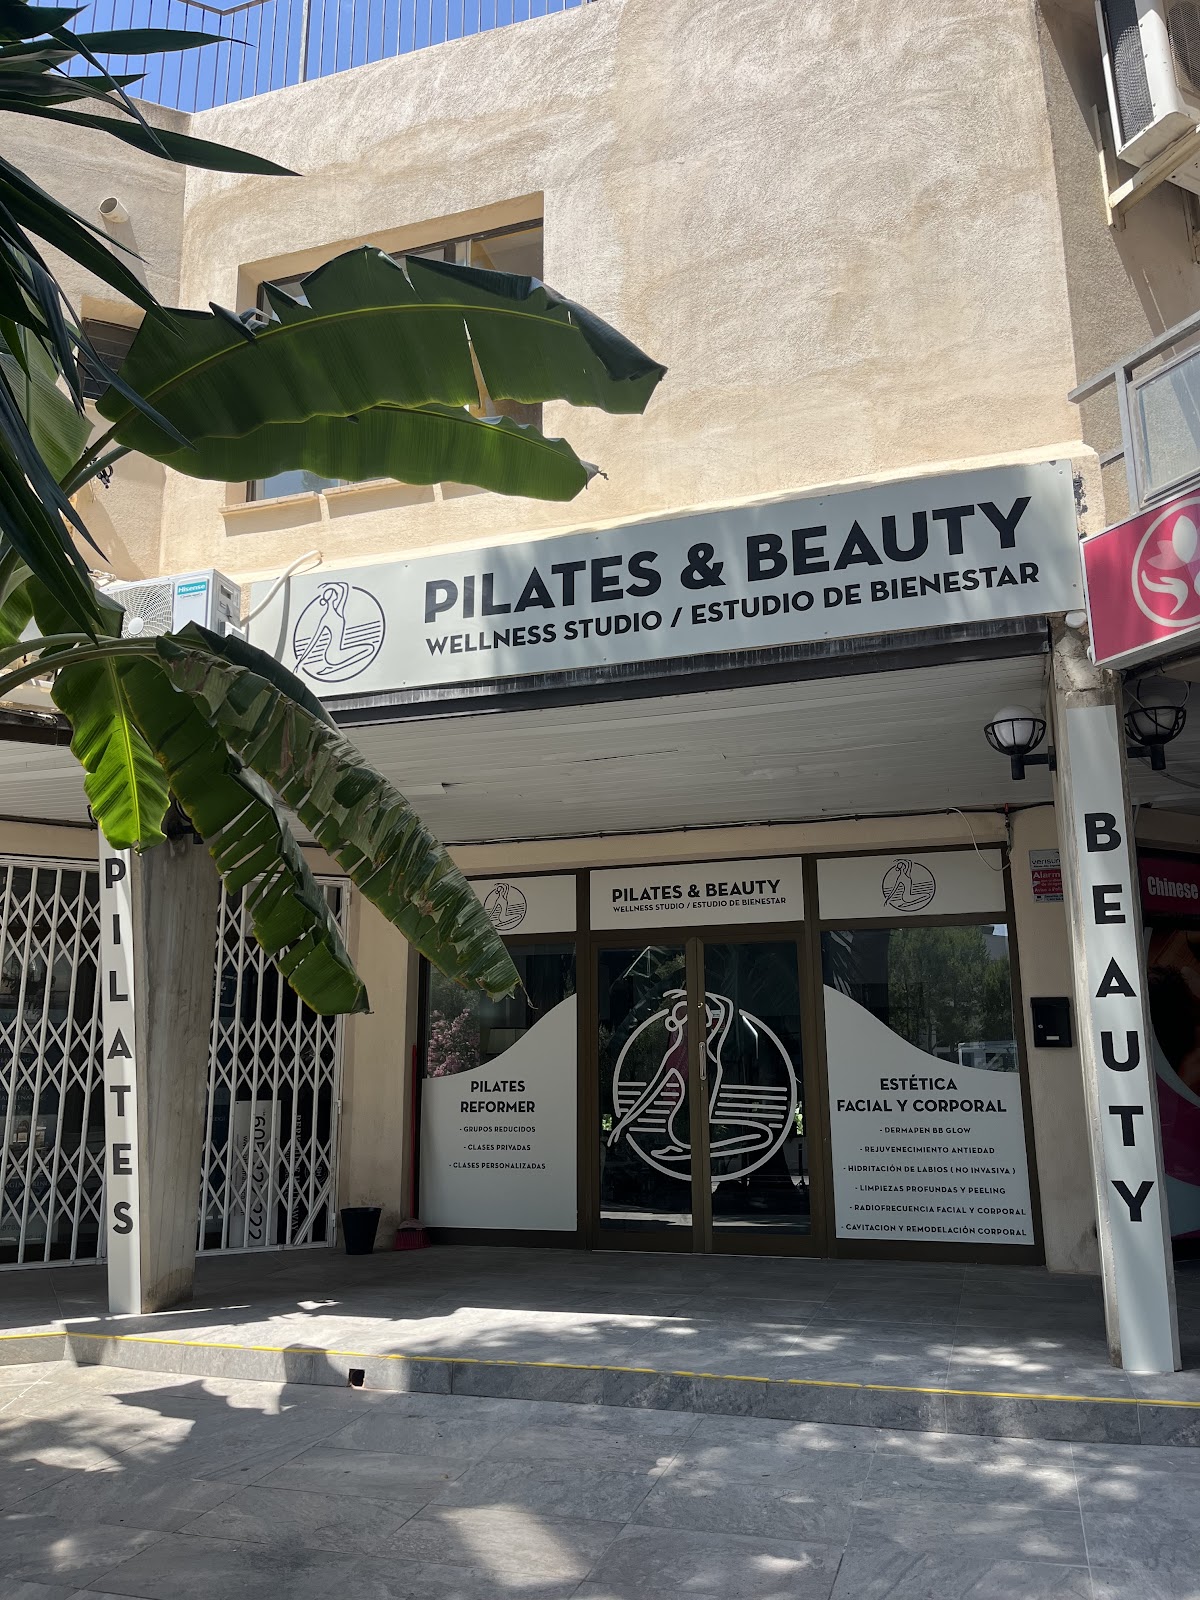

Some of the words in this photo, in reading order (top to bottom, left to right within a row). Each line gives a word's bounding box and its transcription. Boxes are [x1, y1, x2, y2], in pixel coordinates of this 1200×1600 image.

[425, 550, 662, 623] PILATES
[680, 542, 726, 590] &
[746, 496, 1031, 586] BEAUTY
[178, 584, 206, 593] Hisense
[425, 619, 557, 656] WELLNESS
[563, 611, 662, 640] STUDIO
[692, 591, 814, 625] ESTUDIO
[823, 583, 861, 608] DE
[869, 562, 1040, 603] BIENESTAR
[1033, 871, 1061, 879] Alarm
[612, 885, 682, 902] PILATES
[688, 884, 700, 898] &
[706, 879, 780, 897] BEAUTY
[1147, 876, 1199, 900] Chinese
[613, 904, 653, 912] WELLNESS
[655, 902, 685, 910] STUDIO
[693, 900, 727, 908] ESTUDIO
[742, 897, 786, 906] BIENESTAR
[1085, 813, 1154, 1222] BEAUTY
[105, 857, 134, 1236] PILATES
[471, 1080, 525, 1092] PILATES
[880, 1074, 958, 1090] ESTÉTICA
[461, 1101, 535, 1113] REFORMER
[837, 1099, 892, 1112] FACIAL
[896, 1100, 908, 1112] Y
[913, 1099, 1007, 1112] CORPORAL
[848, 1164, 902, 1172] HIDRITACIÓN
[854, 1204, 934, 1213] RADIOFRECUENCIA
[977, 1207, 1026, 1215] CORPORAL
[906, 1225, 975, 1234] REMODELACIÓN
[977, 1228, 1027, 1236] CORPORAL
